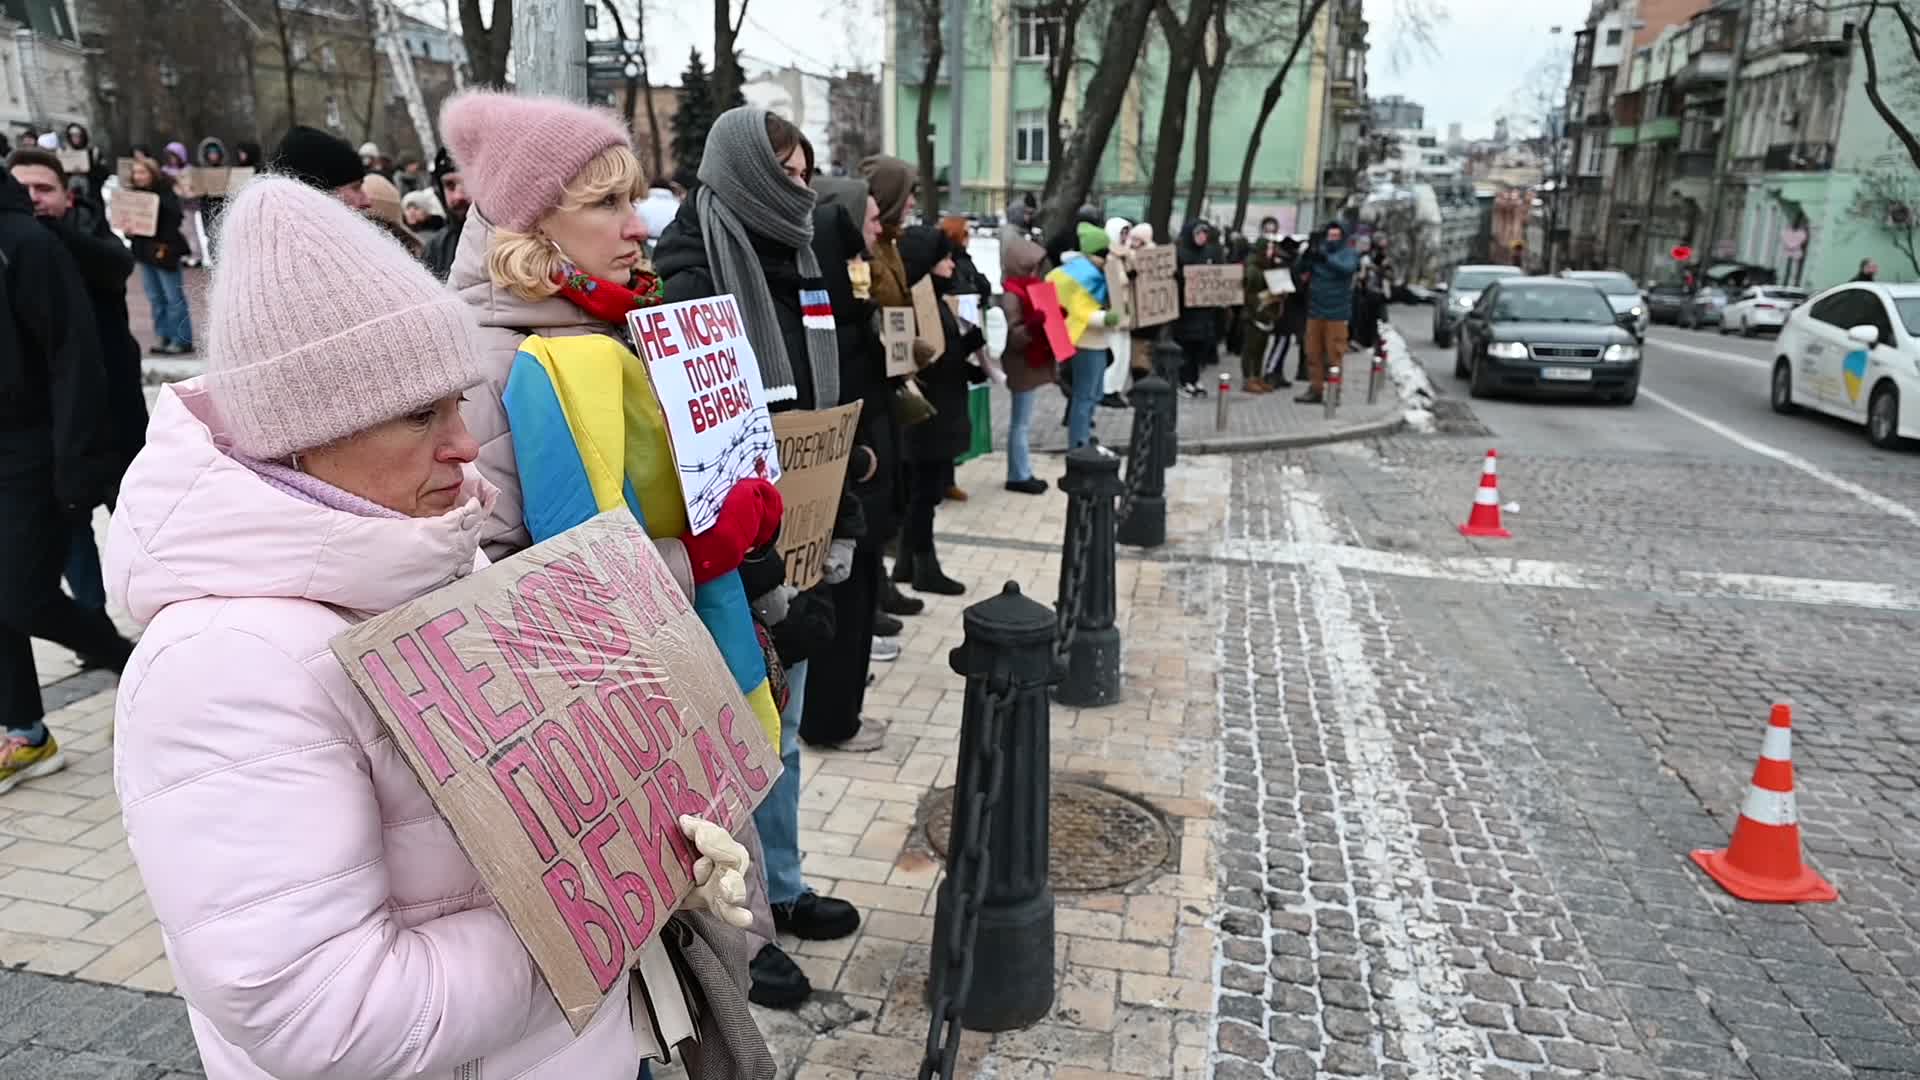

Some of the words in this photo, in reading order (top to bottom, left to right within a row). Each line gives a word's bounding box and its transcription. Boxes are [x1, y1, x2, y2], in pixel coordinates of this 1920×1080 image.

[635, 311, 680, 362] НЕ
[673, 299, 743, 350] МОВЧИ
[359, 608, 532, 785] НЕ
[474, 526, 688, 716] МОВЧИ
[486, 655, 687, 863] ПОЛОН
[542, 703, 769, 995] ВБИВАЄ
